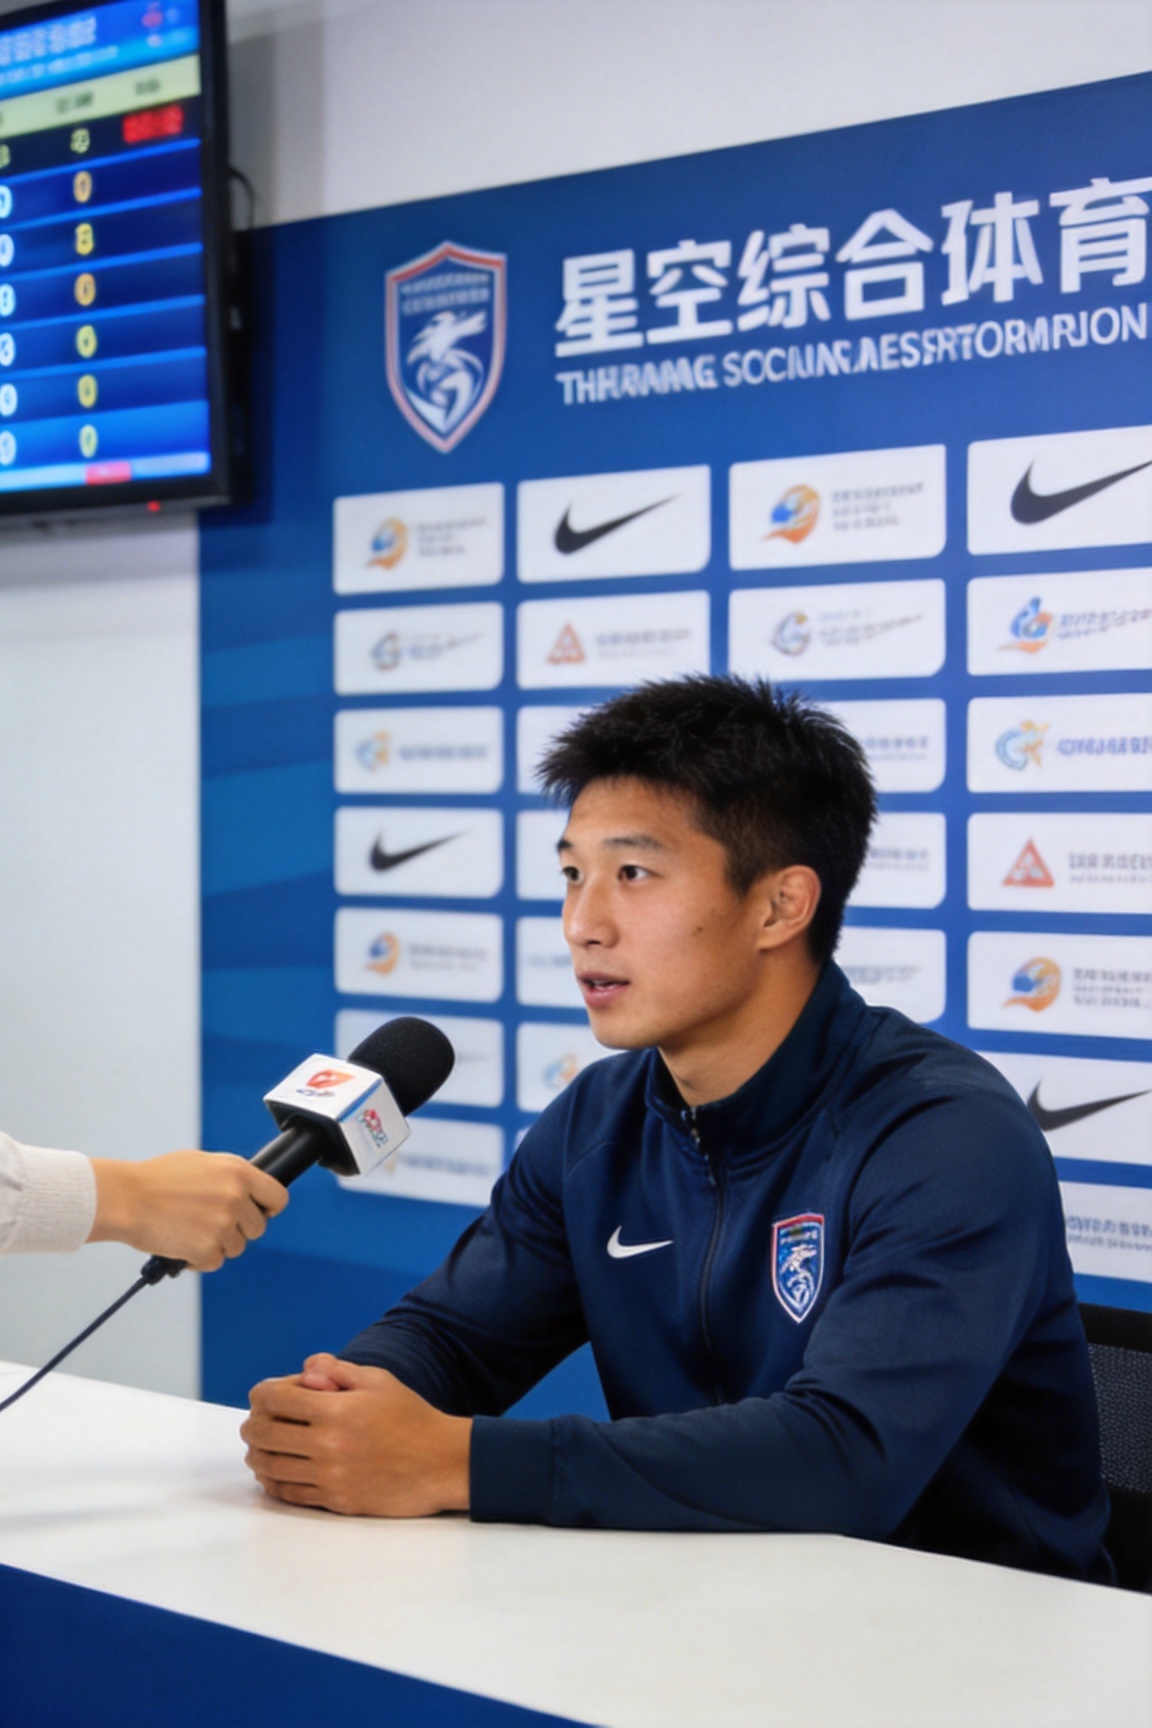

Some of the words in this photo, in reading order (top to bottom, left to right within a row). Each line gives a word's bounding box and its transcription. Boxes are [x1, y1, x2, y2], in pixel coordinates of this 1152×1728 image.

[554, 177, 1152, 358] 星空综合体育
